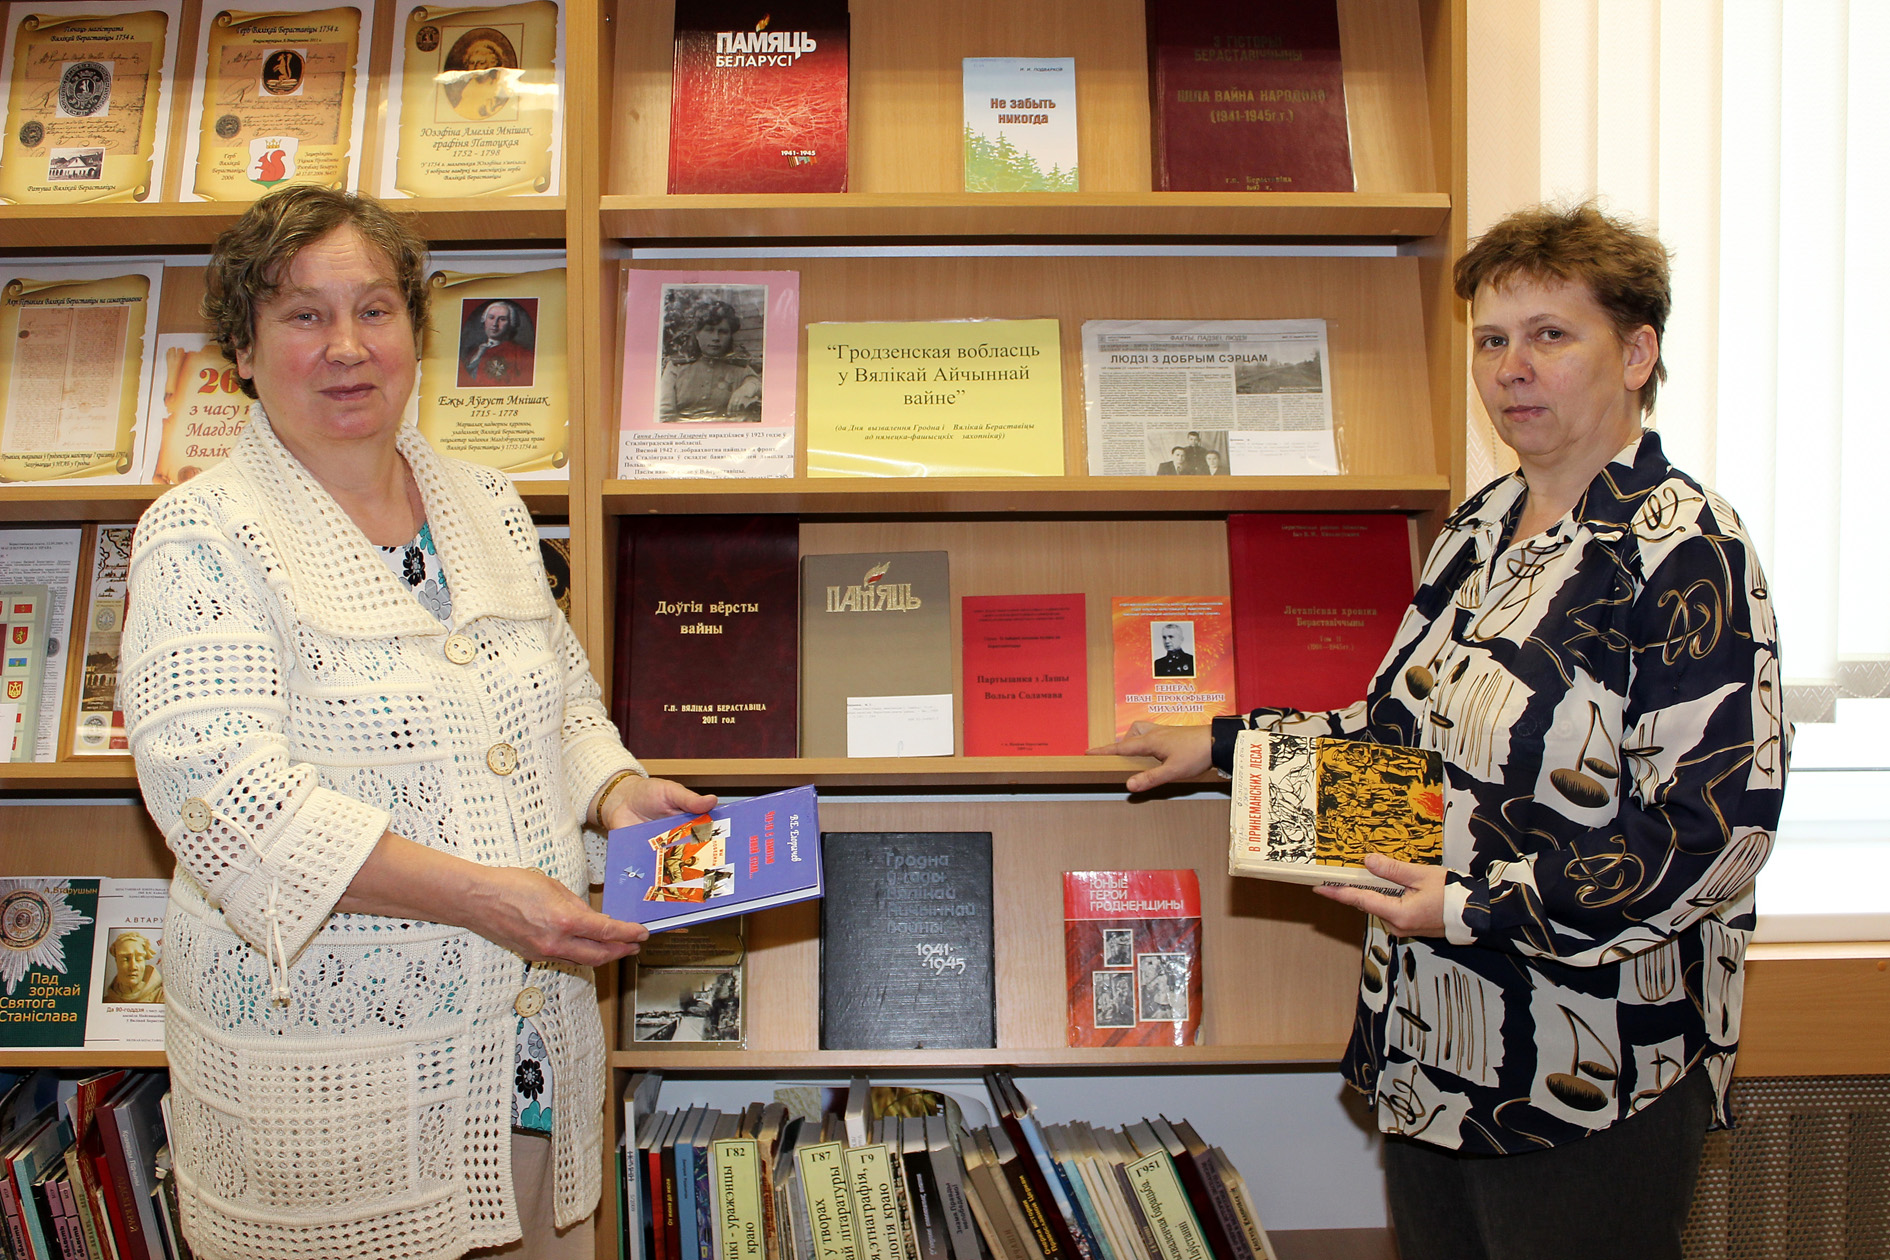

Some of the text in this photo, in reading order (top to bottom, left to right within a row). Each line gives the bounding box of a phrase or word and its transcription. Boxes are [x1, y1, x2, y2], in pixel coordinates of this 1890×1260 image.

[716, 31, 817, 60] ПАМЯЦЬ
[715, 55, 792, 67] БЕЛАРУСІ
[1214, 86, 1326, 103] ВАЙНА НАРОДНАЯ
[990, 97, 1056, 109] Не забыть
[998, 114, 1048, 124] никогда
[462, 127, 494, 137] Амелія
[496, 126, 534, 136] Мнішак
[432, 138, 519, 151] графіня Патоцкая
[480, 149, 501, 157] 1798
[957, 342, 1040, 359] вобласць
[1110, 353, 1268, 364] ЛЮДЗІ З ДОБРЫМ СЭРЦАМ
[198, 367, 240, 395] 26
[838, 365, 1030, 386] у Вялікай Айчыннай
[438, 394, 550, 409] Ежы Аўгуст Мнішак
[189, 405, 198, 416] з
[203, 404, 240, 420] часу
[470, 409, 518, 418] 1715 1778
[185, 420, 247, 438] Магдэб
[913, 424, 939, 432] Гродна
[953, 423, 983, 431] Вялікай
[984, 423, 1035, 432] Бераставіцы
[185, 443, 231, 458] Вялік
[825, 583, 921, 613] ПАМЯЦЬ
[655, 601, 759, 616] Доўгія вёрсты
[680, 622, 723, 635] вайны
[1154, 684, 1195, 693] ГЕНЕРАЛ
[984, 691, 1017, 702] Вольга
[1126, 693, 1225, 703] ИВАН ПРОКОФЬЕВИЧ
[716, 704, 767, 712] БЕРАСТАВІЦА
[1148, 703, 1204, 713] МИХАЙЛИН
[702, 716, 735, 724] 2011 год
[1252, 743, 1263, 770] ЛЕСАХ
[1249, 774, 1263, 842] ПРИНЕМАНСКИХ
[885, 853, 950, 869] Гродна
[1090, 879, 1128, 888] ЮНЫЕ
[1090, 890, 1128, 899] ГЕРОИ
[1090, 900, 1184, 912] ГРОДНЕНЩИНЫ
[30, 972, 59, 986] Пад
[28, 984, 81, 998] зоркай
[0, 997, 56, 1009] Святога
[0, 1010, 78, 1022] Станіслава
[725, 1147, 746, 1157] Г82
[811, 1152, 831, 1163] Г87
[860, 1152, 875, 1164] Г9
[1135, 1159, 1160, 1178] Г951
[723, 1165, 738, 1230] уражэнцы
[830, 1165, 852, 1240] літаратуры
[879, 1183, 895, 1220] краю
[1018, 1174, 1058, 1252] Православной Церкви
[815, 1198, 837, 1257] у творах
[1022, 1199, 1051, 1255] Очерки истории
[747, 1221, 760, 1254] краю
